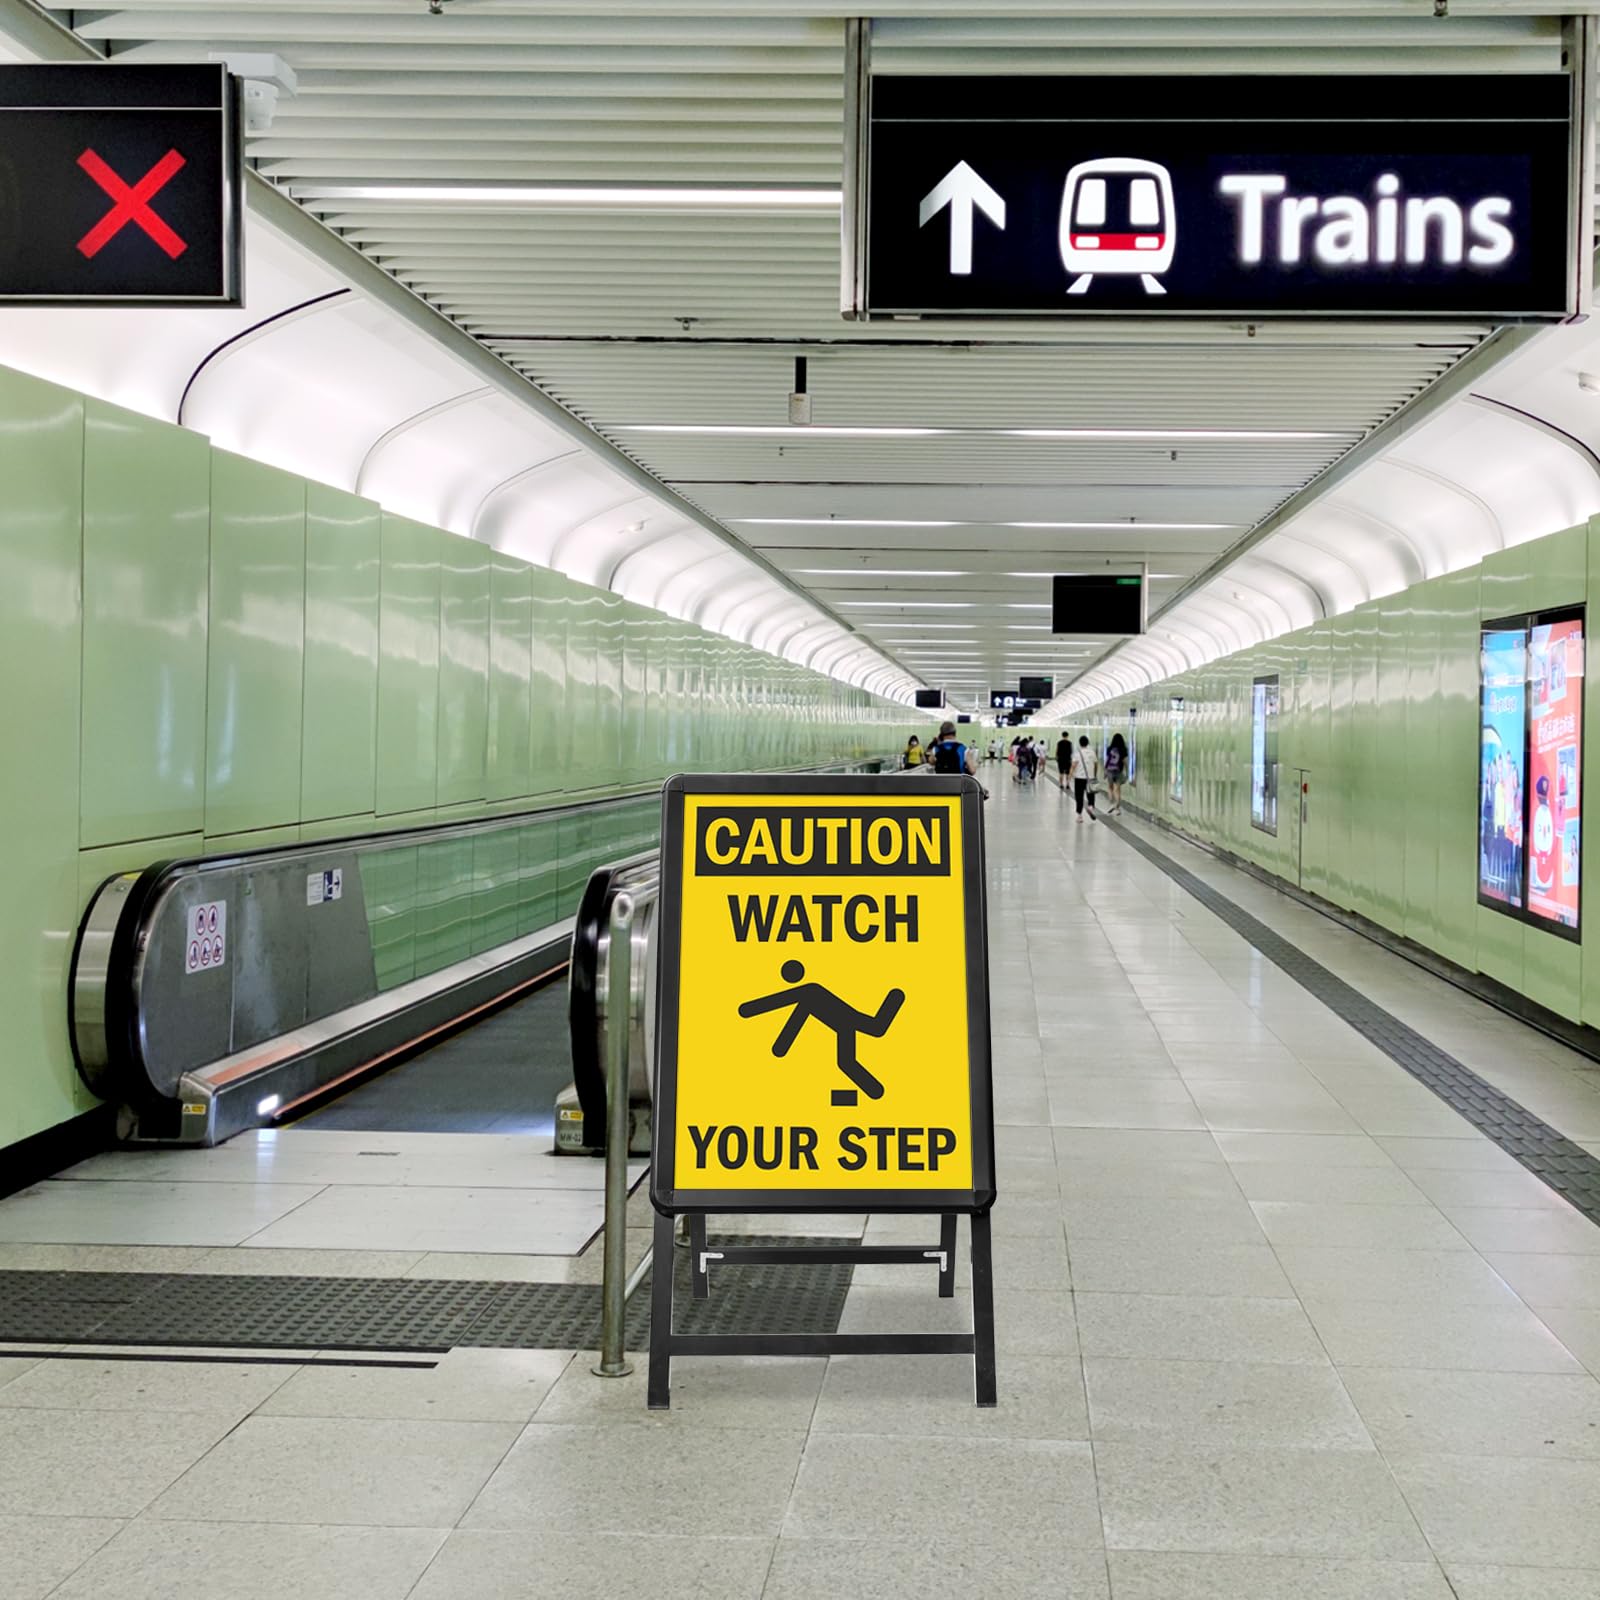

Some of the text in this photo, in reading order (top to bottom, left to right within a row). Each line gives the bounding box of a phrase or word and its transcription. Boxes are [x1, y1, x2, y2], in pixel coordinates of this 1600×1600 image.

[1219, 172, 1515, 267] Trains
[704, 817, 942, 866] CAUTION
[727, 894, 920, 943] WATCH
[687, 1125, 957, 1172] YOUR STEP
